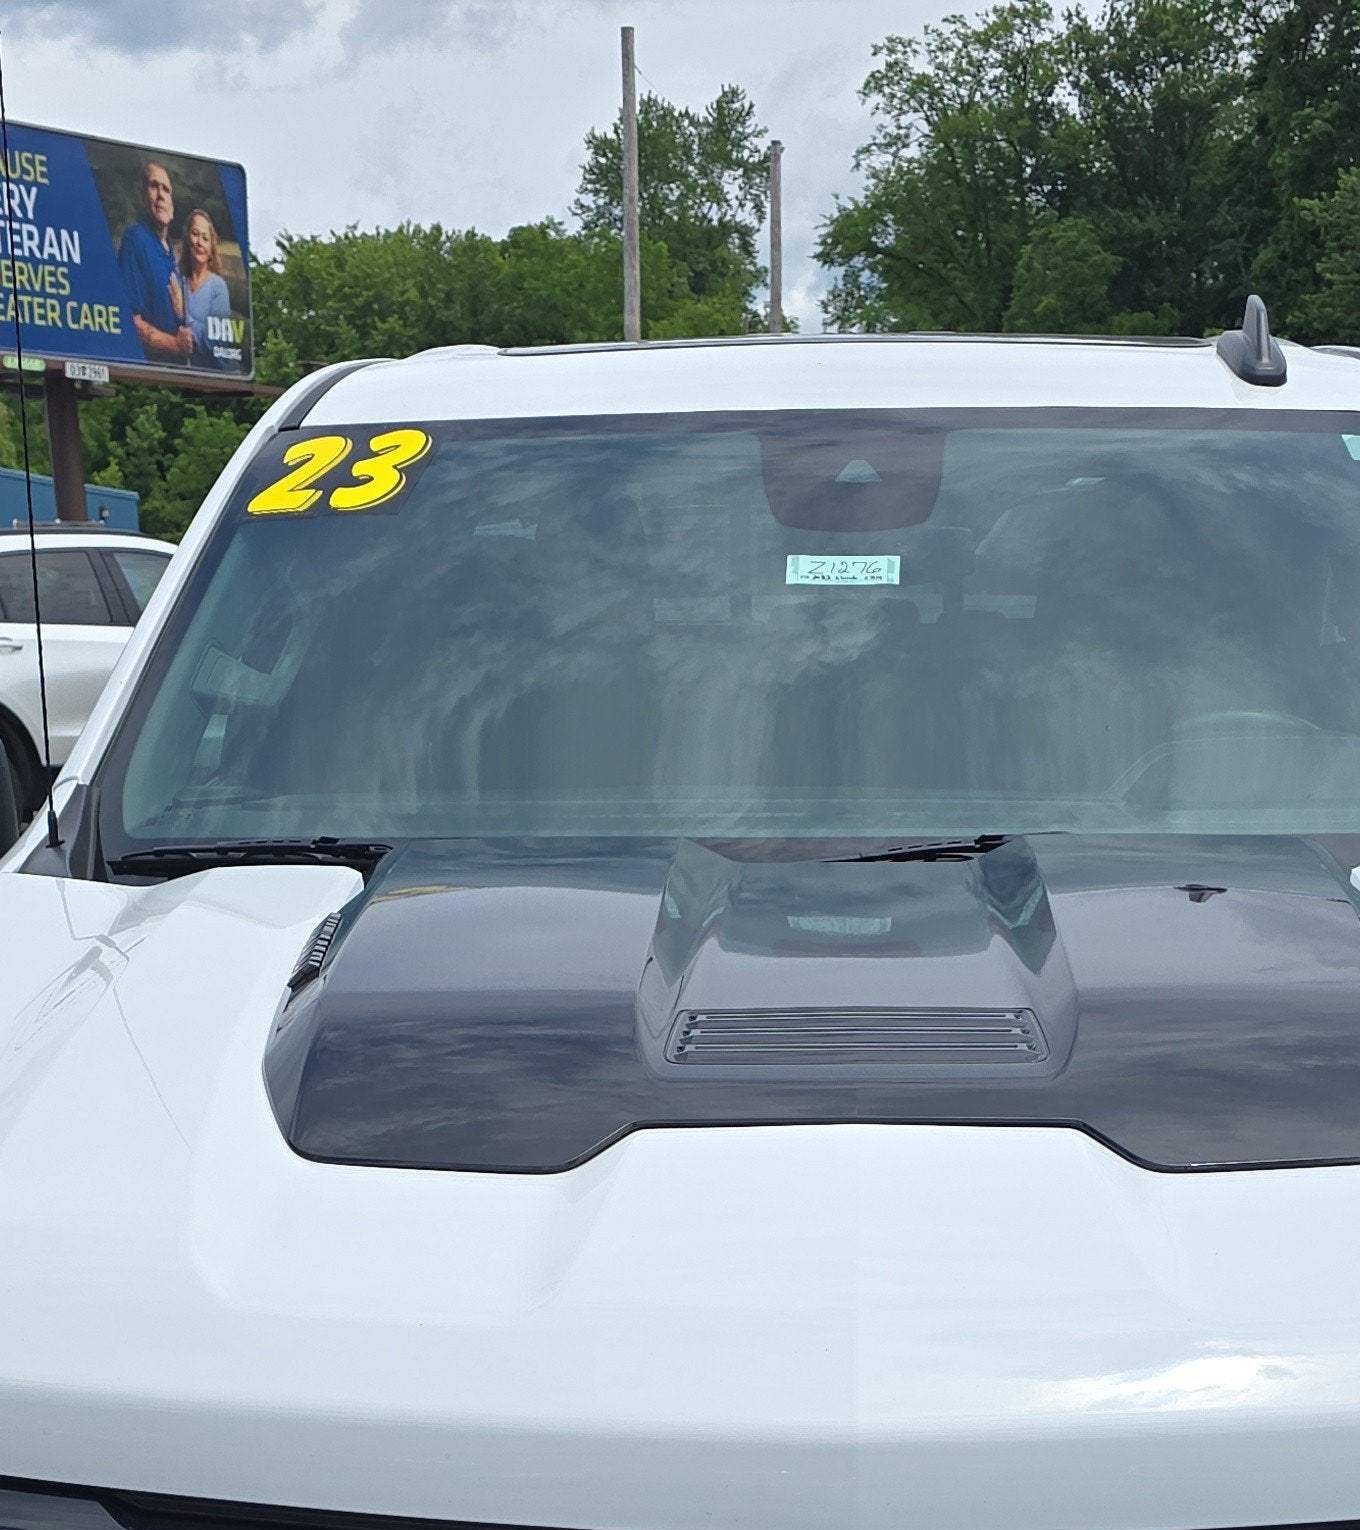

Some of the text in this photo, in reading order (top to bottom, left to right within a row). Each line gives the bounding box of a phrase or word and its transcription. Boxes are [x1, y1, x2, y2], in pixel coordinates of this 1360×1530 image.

[66, 302, 122, 335] CARE
[207, 315, 244, 344] DAV
[247, 429, 433, 515] 23
[808, 560, 882, 575] Z1276
